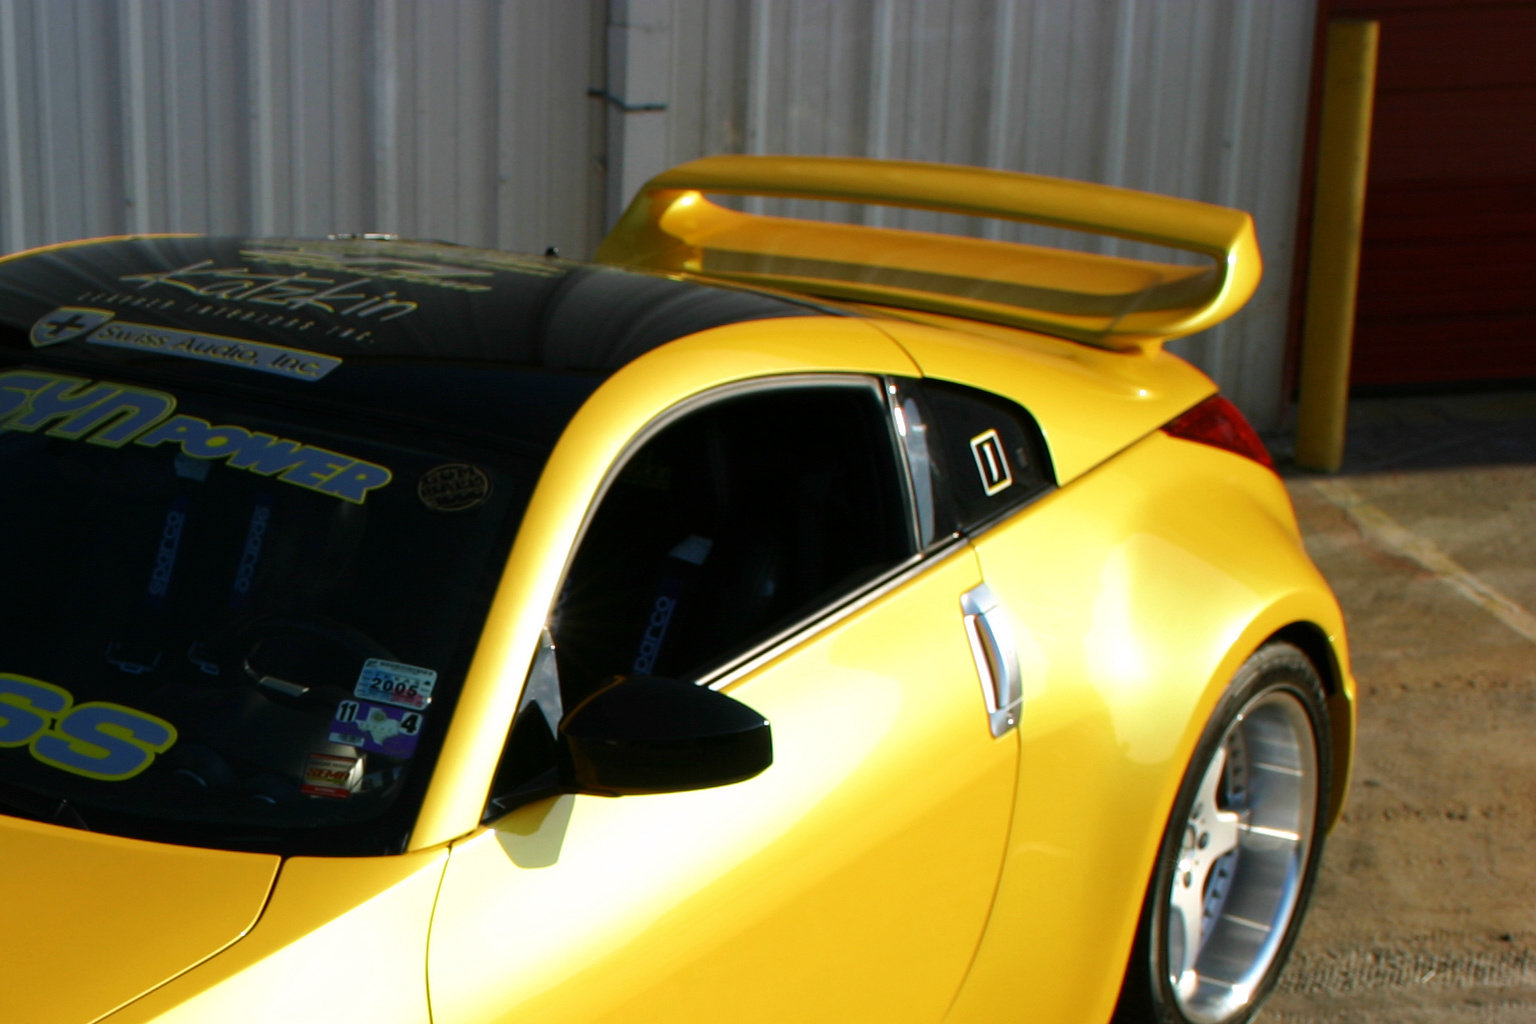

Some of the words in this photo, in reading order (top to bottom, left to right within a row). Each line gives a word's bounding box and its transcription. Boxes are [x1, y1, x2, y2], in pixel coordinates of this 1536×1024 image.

[98, 326, 170, 348] Swiss
[171, 337, 258, 366] Audio,
[269, 352, 321, 377] Inc.
[632, 594, 672, 675] parco
[370, 677, 419, 698] 2005
[339, 702, 357, 722] 11
[401, 714, 419, 734] 4
